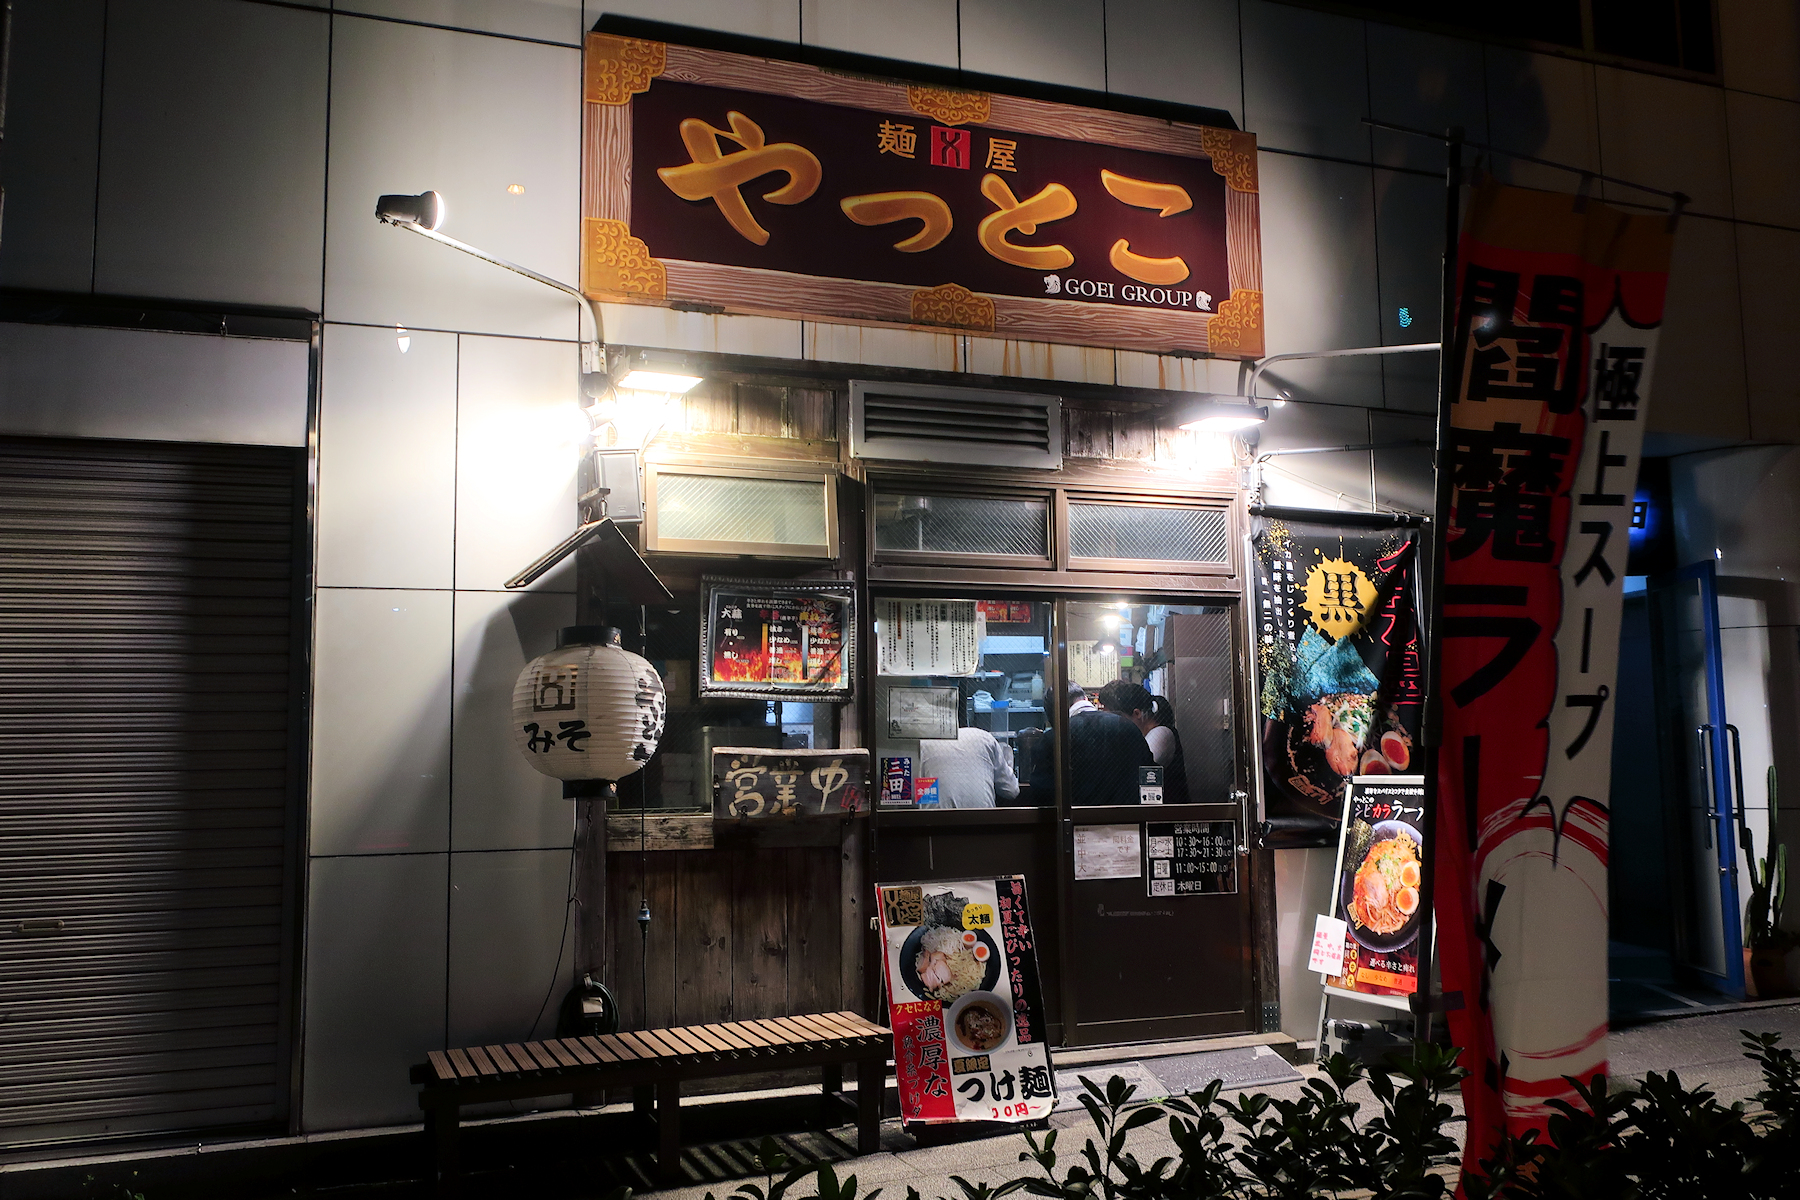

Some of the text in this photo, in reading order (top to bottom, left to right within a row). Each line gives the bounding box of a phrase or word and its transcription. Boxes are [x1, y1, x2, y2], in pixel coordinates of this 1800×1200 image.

[877, 119, 1018, 174] 麺 屋
[656, 110, 1194, 286] やっとこ
[1065, 276, 1194, 308] GOEI GROUP
[1565, 342, 1646, 761] 極上スープ
[1319, 569, 1367, 624] 黒
[523, 720, 592, 754] みそ
[724, 754, 850, 817] 営業中
[888, 760, 905, 793] 三田
[1173, 823, 1210, 835] 営業時間
[1077, 848, 1086, 858] 中
[1077, 863, 1087, 873] 大
[1152, 881, 1173, 893] 定休日
[967, 913, 991, 926] 太麺
[1010, 881, 1033, 952] 旨くて辛い
[895, 1000, 941, 1015] クセになる
[915, 1014, 949, 1098] 濃厚な
[956, 1065, 1052, 1102] つけ麺
